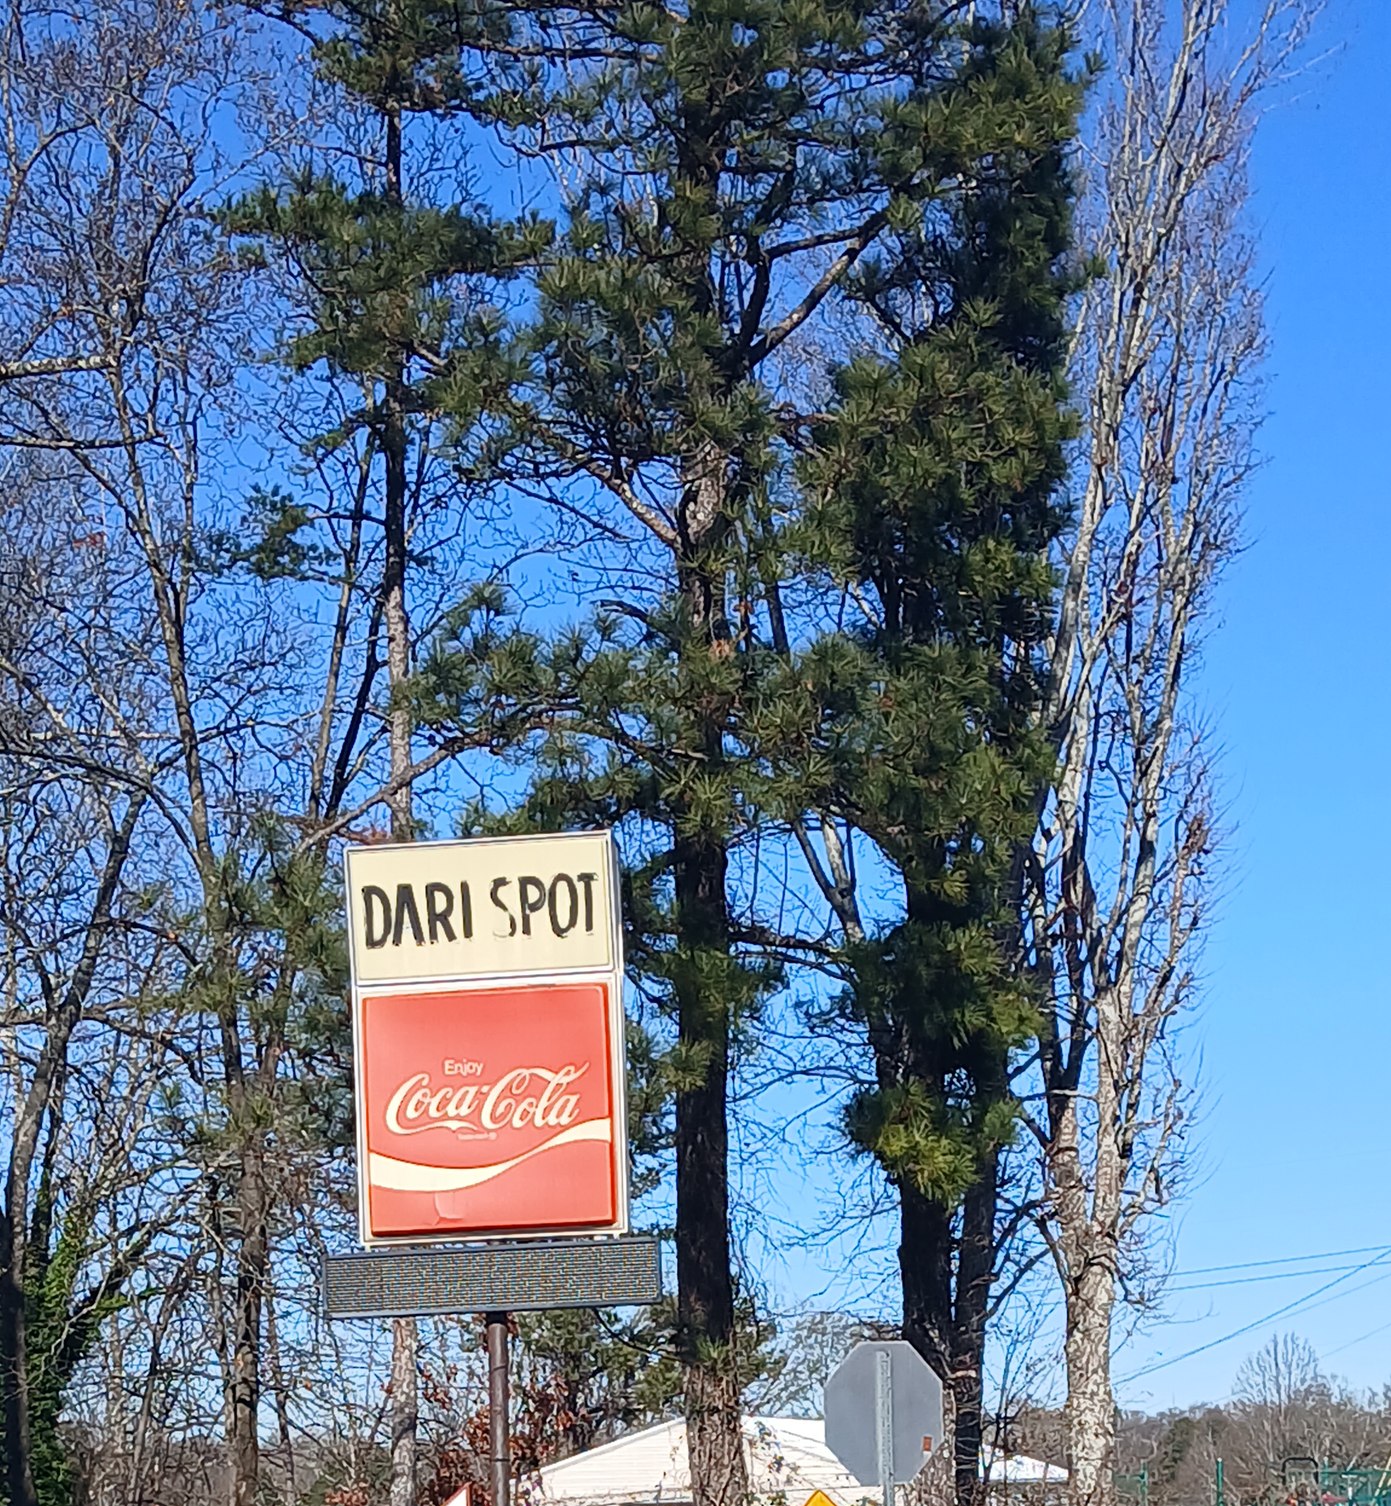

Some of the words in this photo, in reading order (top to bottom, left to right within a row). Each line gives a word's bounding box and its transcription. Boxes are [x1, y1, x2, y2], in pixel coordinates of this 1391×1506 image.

[362, 880, 473, 949] DARI
[490, 873, 599, 938] SPOT
[386, 1062, 590, 1135] Coca-Cola
[443, 1059, 484, 1077] Enjoy
